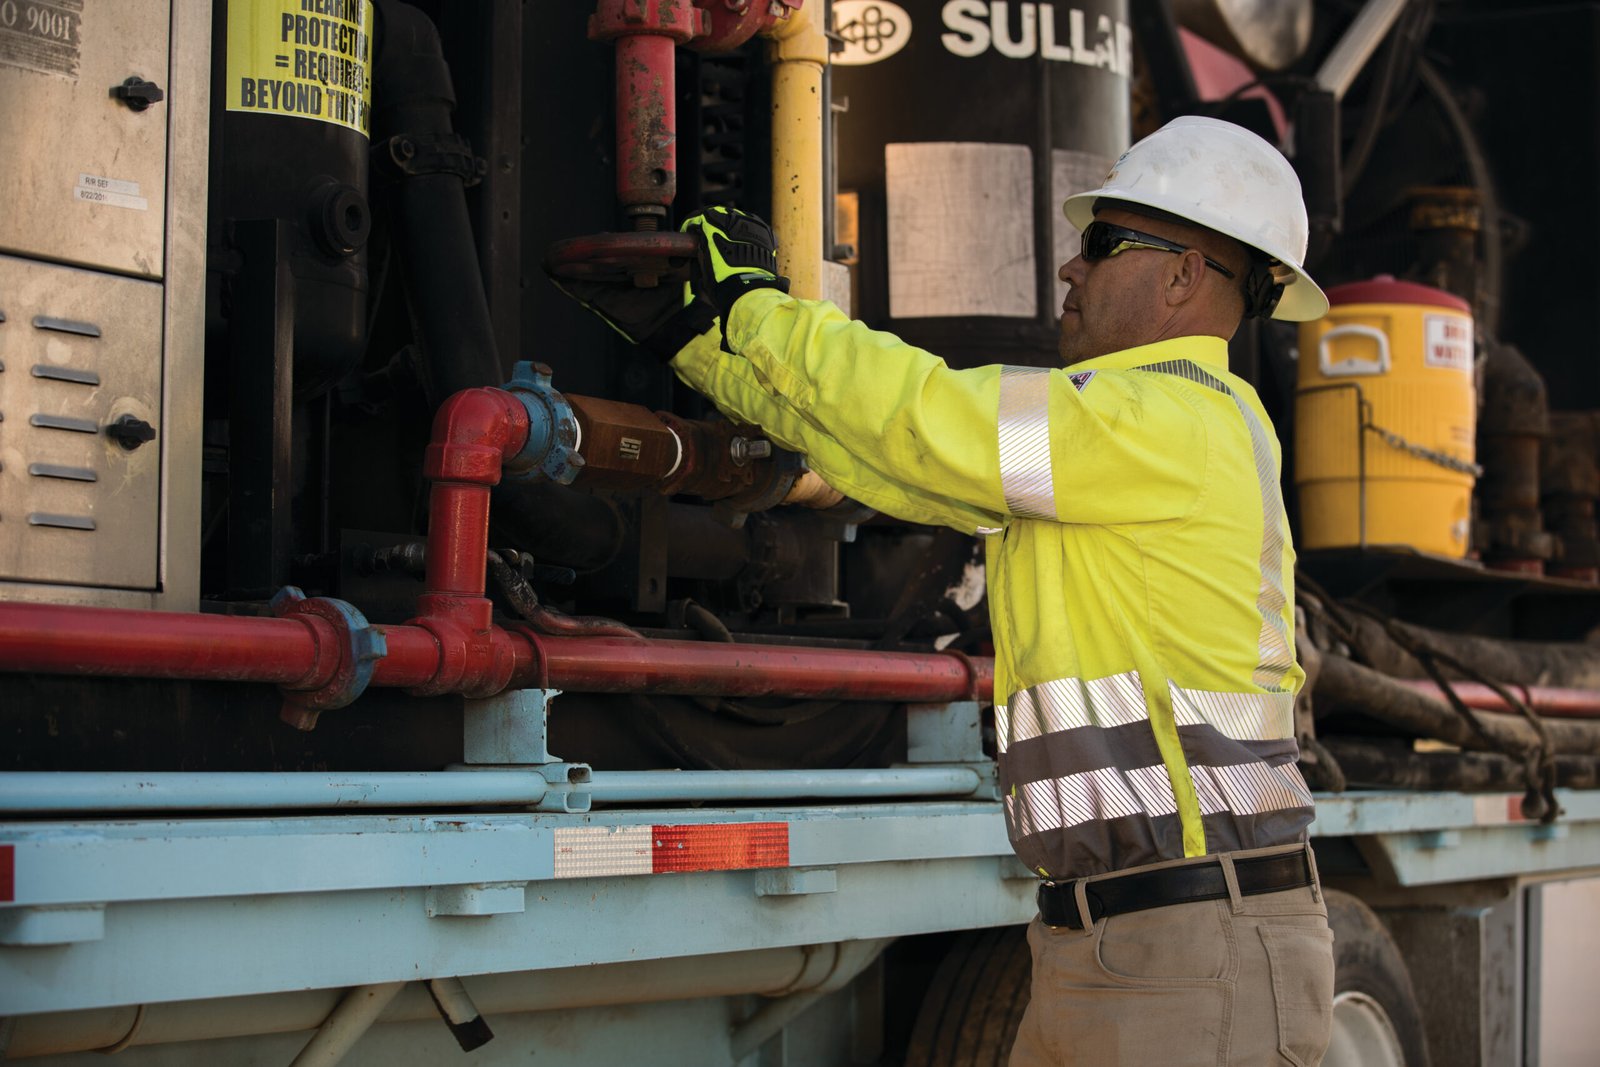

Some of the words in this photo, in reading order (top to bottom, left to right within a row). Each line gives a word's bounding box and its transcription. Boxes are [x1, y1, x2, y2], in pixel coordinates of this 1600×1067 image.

[27, 6, 70, 40] 9001
[281, 12, 368, 64] PROTECTION
[294, 48, 363, 94] REQUIRED
[241, 77, 322, 115] BEYOND
[326, 87, 356, 125] THIS
